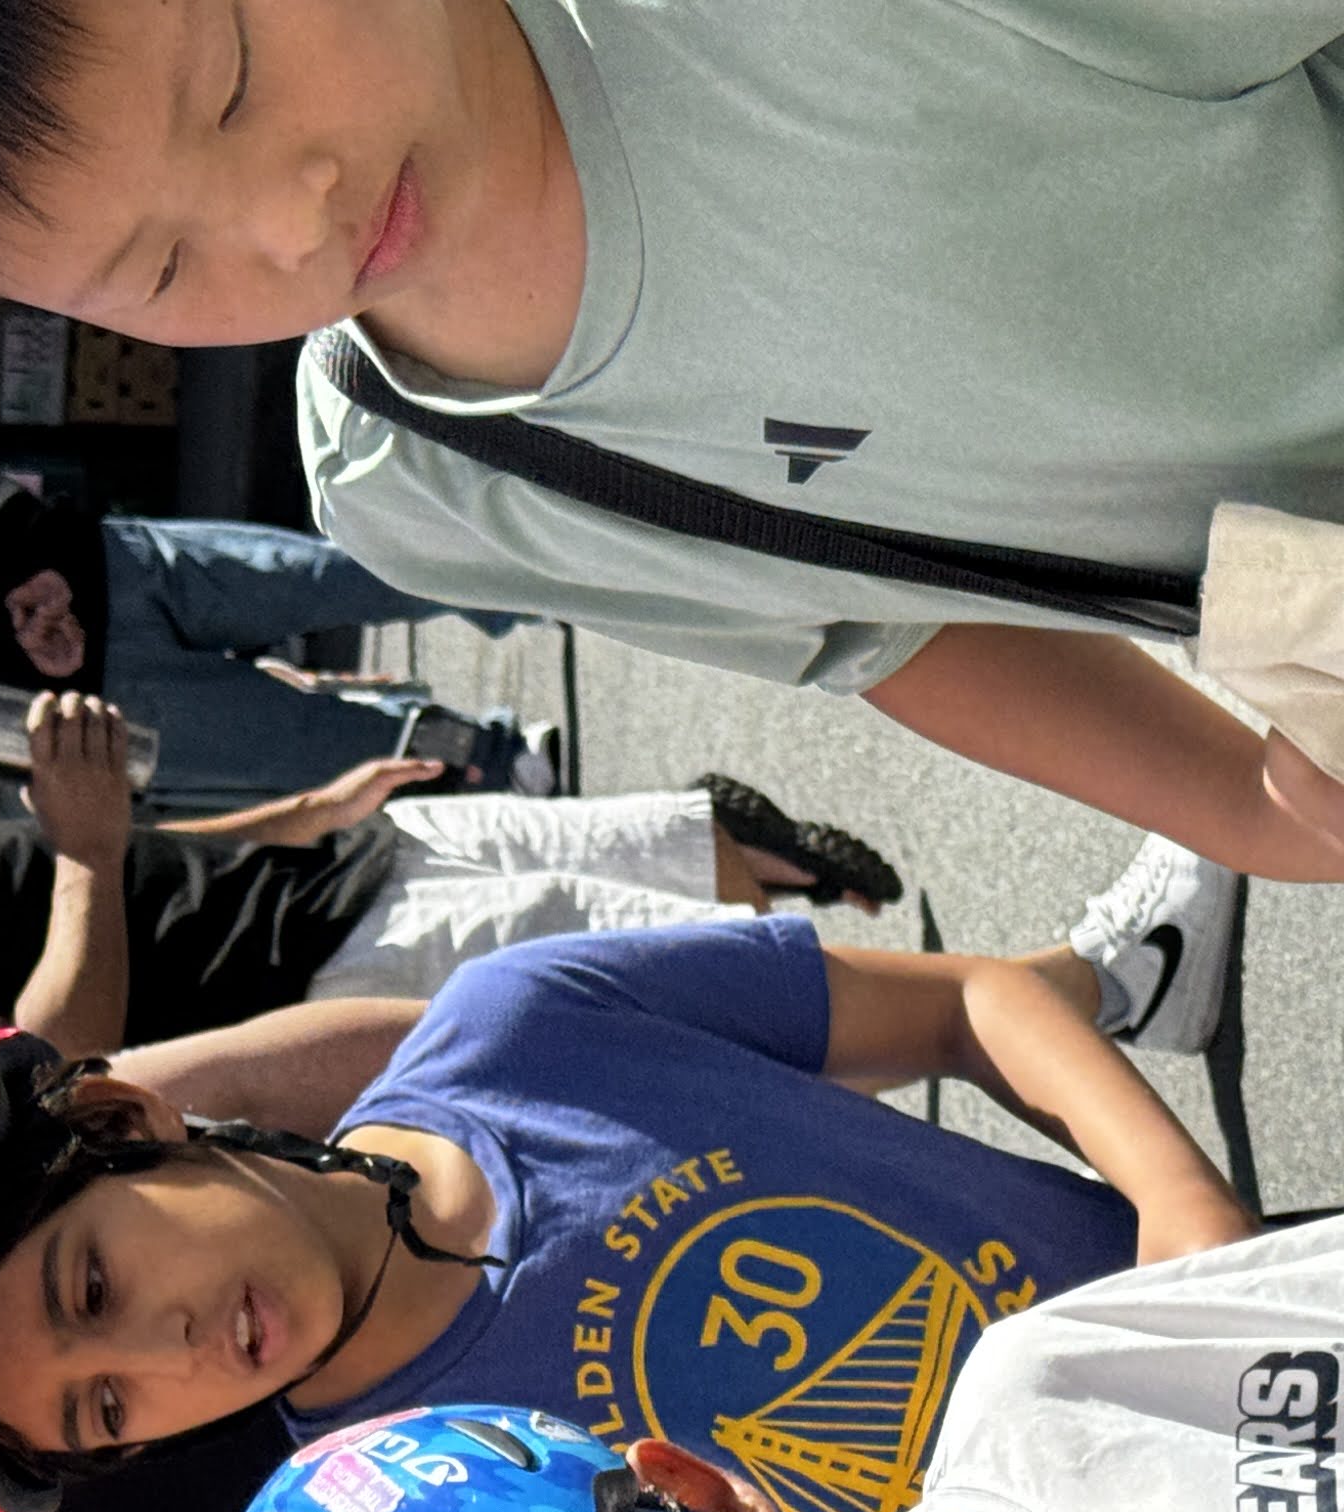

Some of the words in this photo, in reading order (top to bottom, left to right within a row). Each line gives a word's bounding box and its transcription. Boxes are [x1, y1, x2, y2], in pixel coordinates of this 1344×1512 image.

[572, 1276, 632, 1455] LDEN
[603, 1146, 746, 1262] STATE
[699, 1239, 824, 1373] 30
